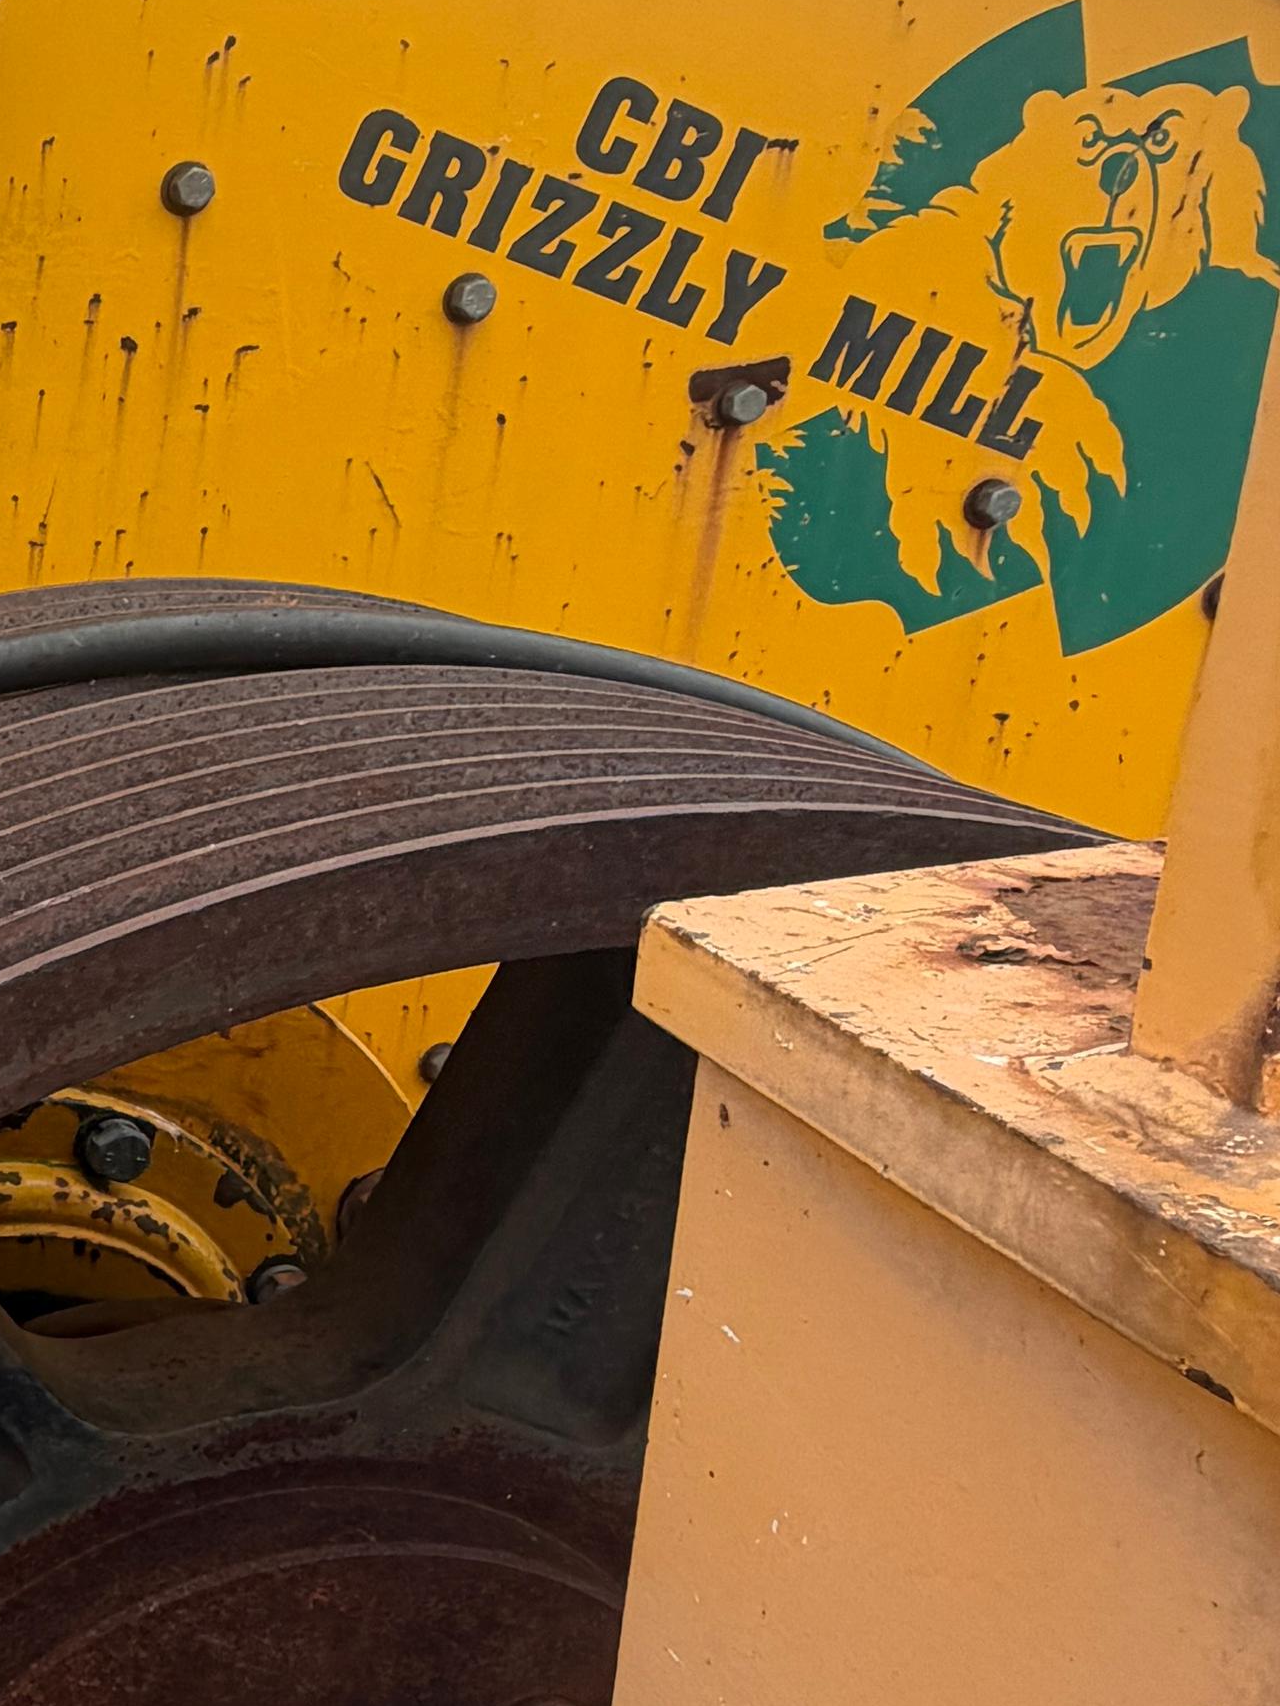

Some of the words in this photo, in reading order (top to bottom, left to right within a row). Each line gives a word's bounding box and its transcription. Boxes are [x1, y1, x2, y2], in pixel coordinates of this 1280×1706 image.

[576, 76, 770, 225] CBI
[338, 109, 787, 346] GRIZZLY
[808, 296, 1044, 460] MILL
